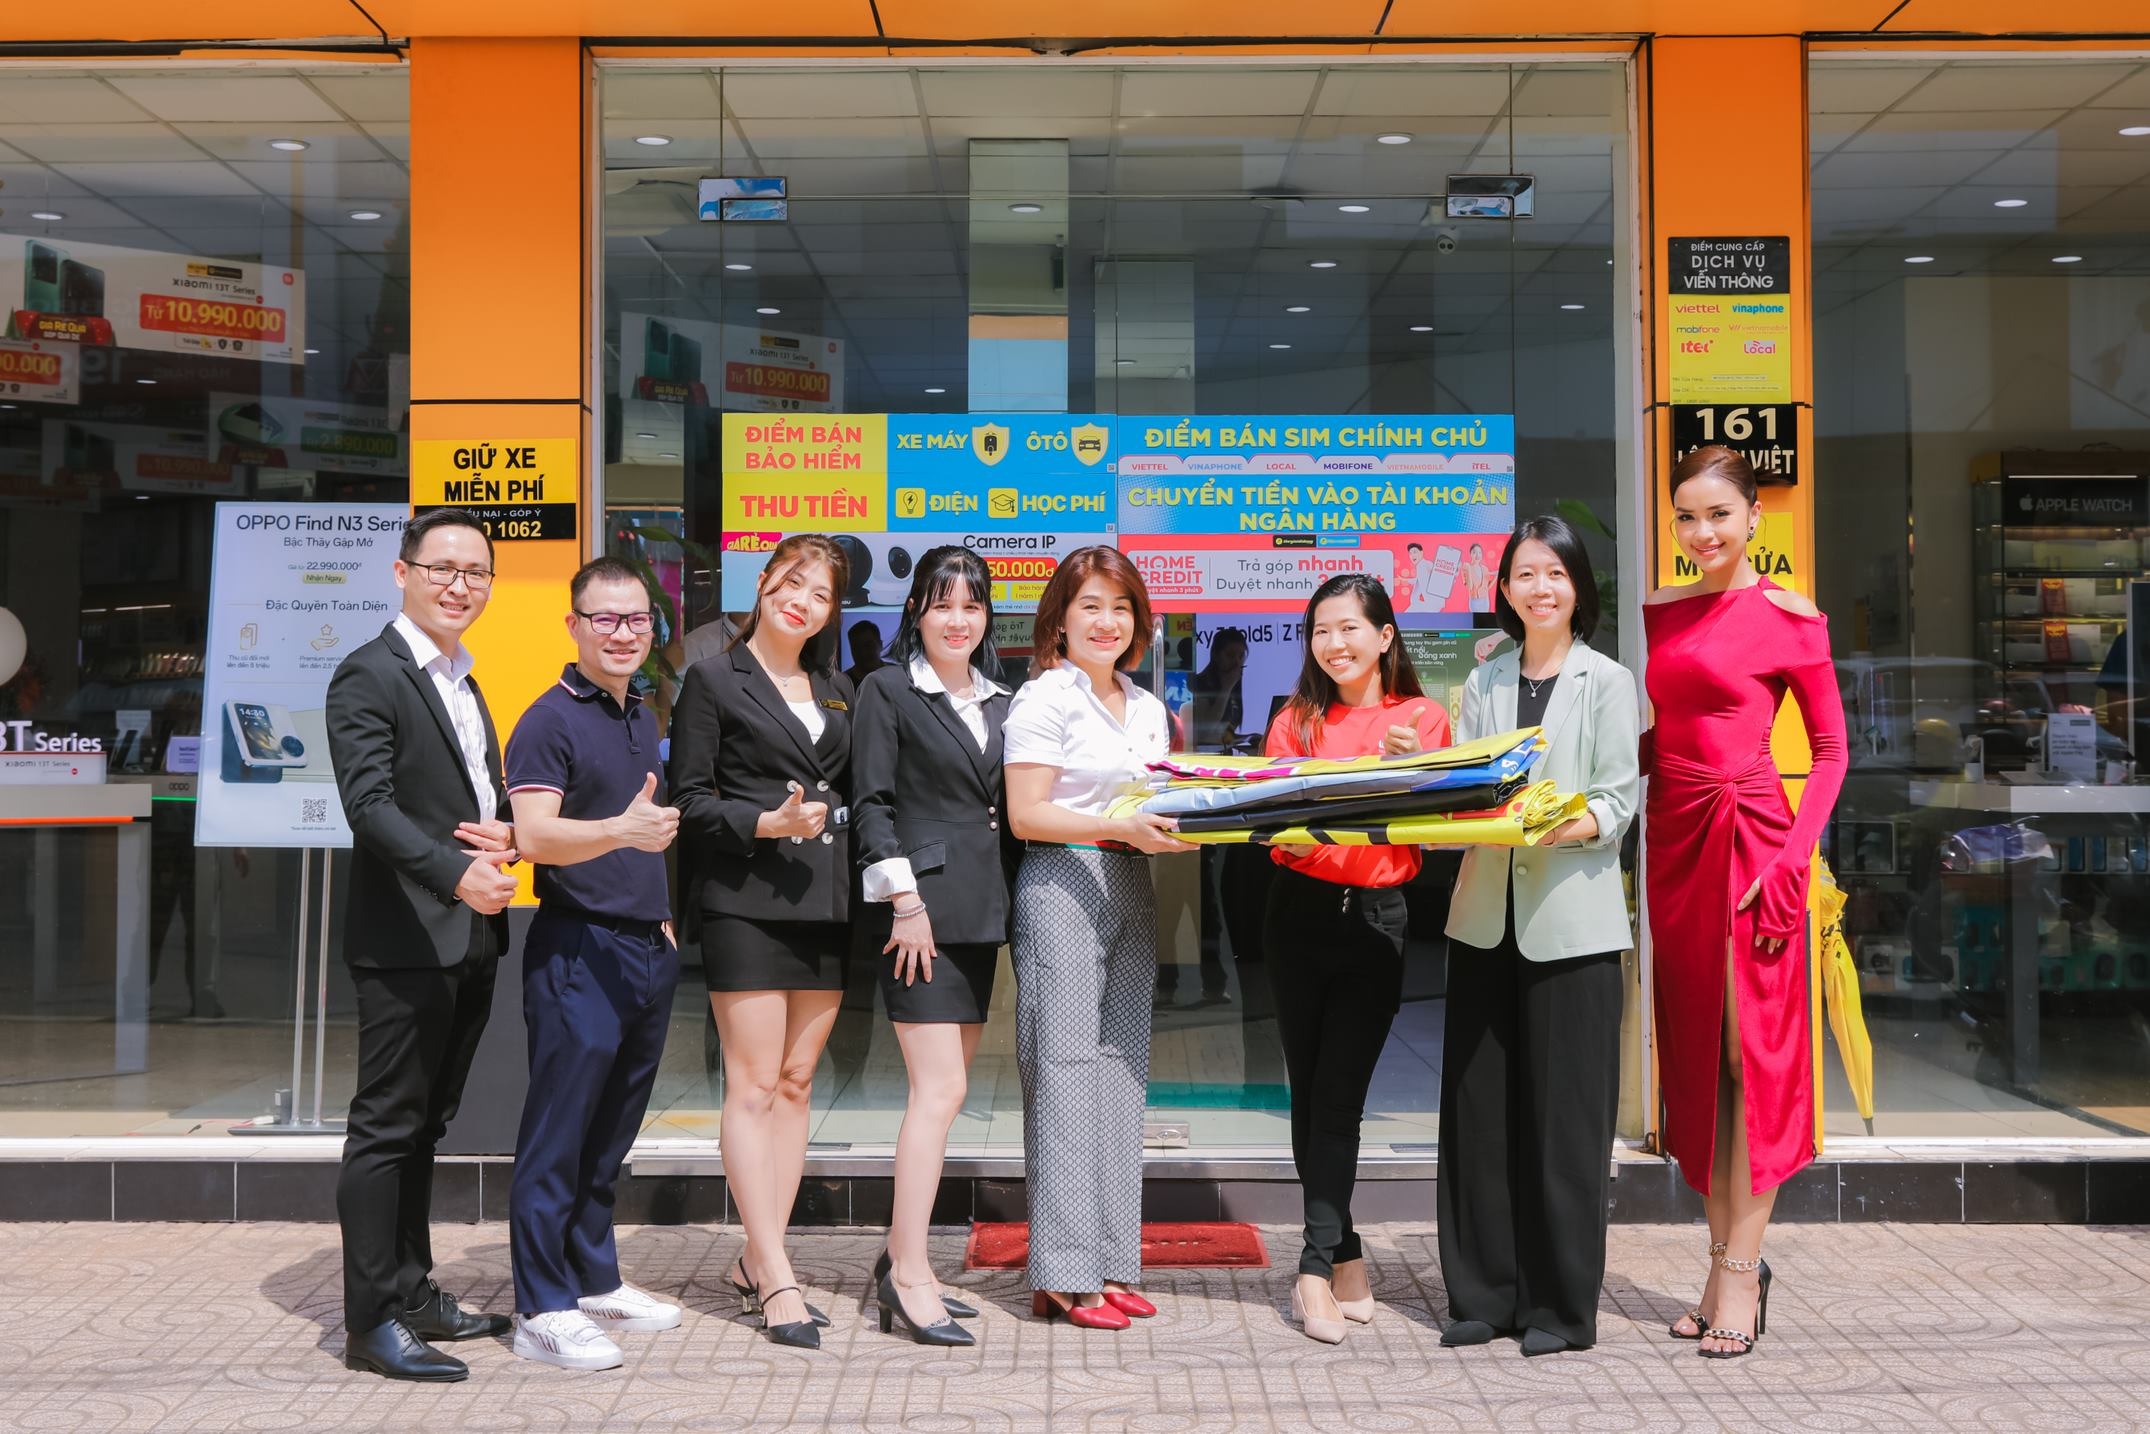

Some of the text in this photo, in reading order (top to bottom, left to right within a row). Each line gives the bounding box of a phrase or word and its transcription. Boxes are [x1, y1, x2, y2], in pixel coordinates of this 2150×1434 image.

[1690, 240, 1766, 252] ĐIỂM CUNG CẤP
[1691, 255, 1766, 272] DỊCH VỤ
[172, 277, 256, 295] xiaomi 13T Series
[1683, 269, 1775, 289] VIỄN THÔNG
[166, 302, 282, 332] 10.990.000
[1675, 303, 1785, 315] viettel vinaphone
[1676, 325, 1720, 334] mobifone
[0, 353, 56, 376] 0.000
[744, 367, 828, 393] 10.990.000
[745, 418, 862, 443] ĐIỂM BÁN
[1144, 418, 1487, 448] ĐIỂM BÁN SIM CHÍNH CHỦ
[1696, 407, 1777, 441] 161
[896, 433, 922, 449] XE
[926, 430, 969, 449] MÁY
[453, 442, 537, 470] GIỮ XE
[745, 444, 861, 470] BẢO HIỂM
[1131, 463, 1168, 471] VIETTEL
[1188, 463, 1243, 471] VINAPHONE
[1266, 463, 1297, 471] LOCAL
[1323, 462, 1373, 471] MOBIFONE
[1387, 463, 1444, 471] VIETNAMOBILE
[444, 472, 545, 502] MIỄN PHÍ
[1127, 477, 1234, 507] CHUYỂN
[1306, 481, 1359, 506] VÀO
[1366, 481, 1406, 506] TÀI
[1414, 479, 1507, 506] KHOẢN
[739, 487, 868, 518] THU TIỀN
[928, 490, 1107, 516] ĐIỆN HỌC PHÍ
[2035, 498, 2133, 512] APPLE WATCH
[236, 514, 290, 531] OPPO
[295, 514, 333, 531] Find
[337, 515, 363, 531] N3
[482, 510, 501, 519] NẠI
[509, 508, 532, 517] GÓP
[534, 507, 542, 517] Ý
[1239, 507, 1396, 531] NGÂN HÀNG
[498, 520, 542, 537] 1062
[283, 536, 303, 548] Bậc
[963, 534, 1056, 549] Camera IP
[1136, 555, 1363, 575] HOME Trả góp nhanh
[1675, 555, 1698, 577] M
[1748, 546, 1793, 575] ỬA
[1216, 577, 1262, 593] Duyệt
[1267, 577, 1313, 590] nhanh
[265, 600, 388, 612] Đặc Quyền Toàn Diện
[1439, 651, 1457, 659] xanh
[35, 731, 102, 751] Series
